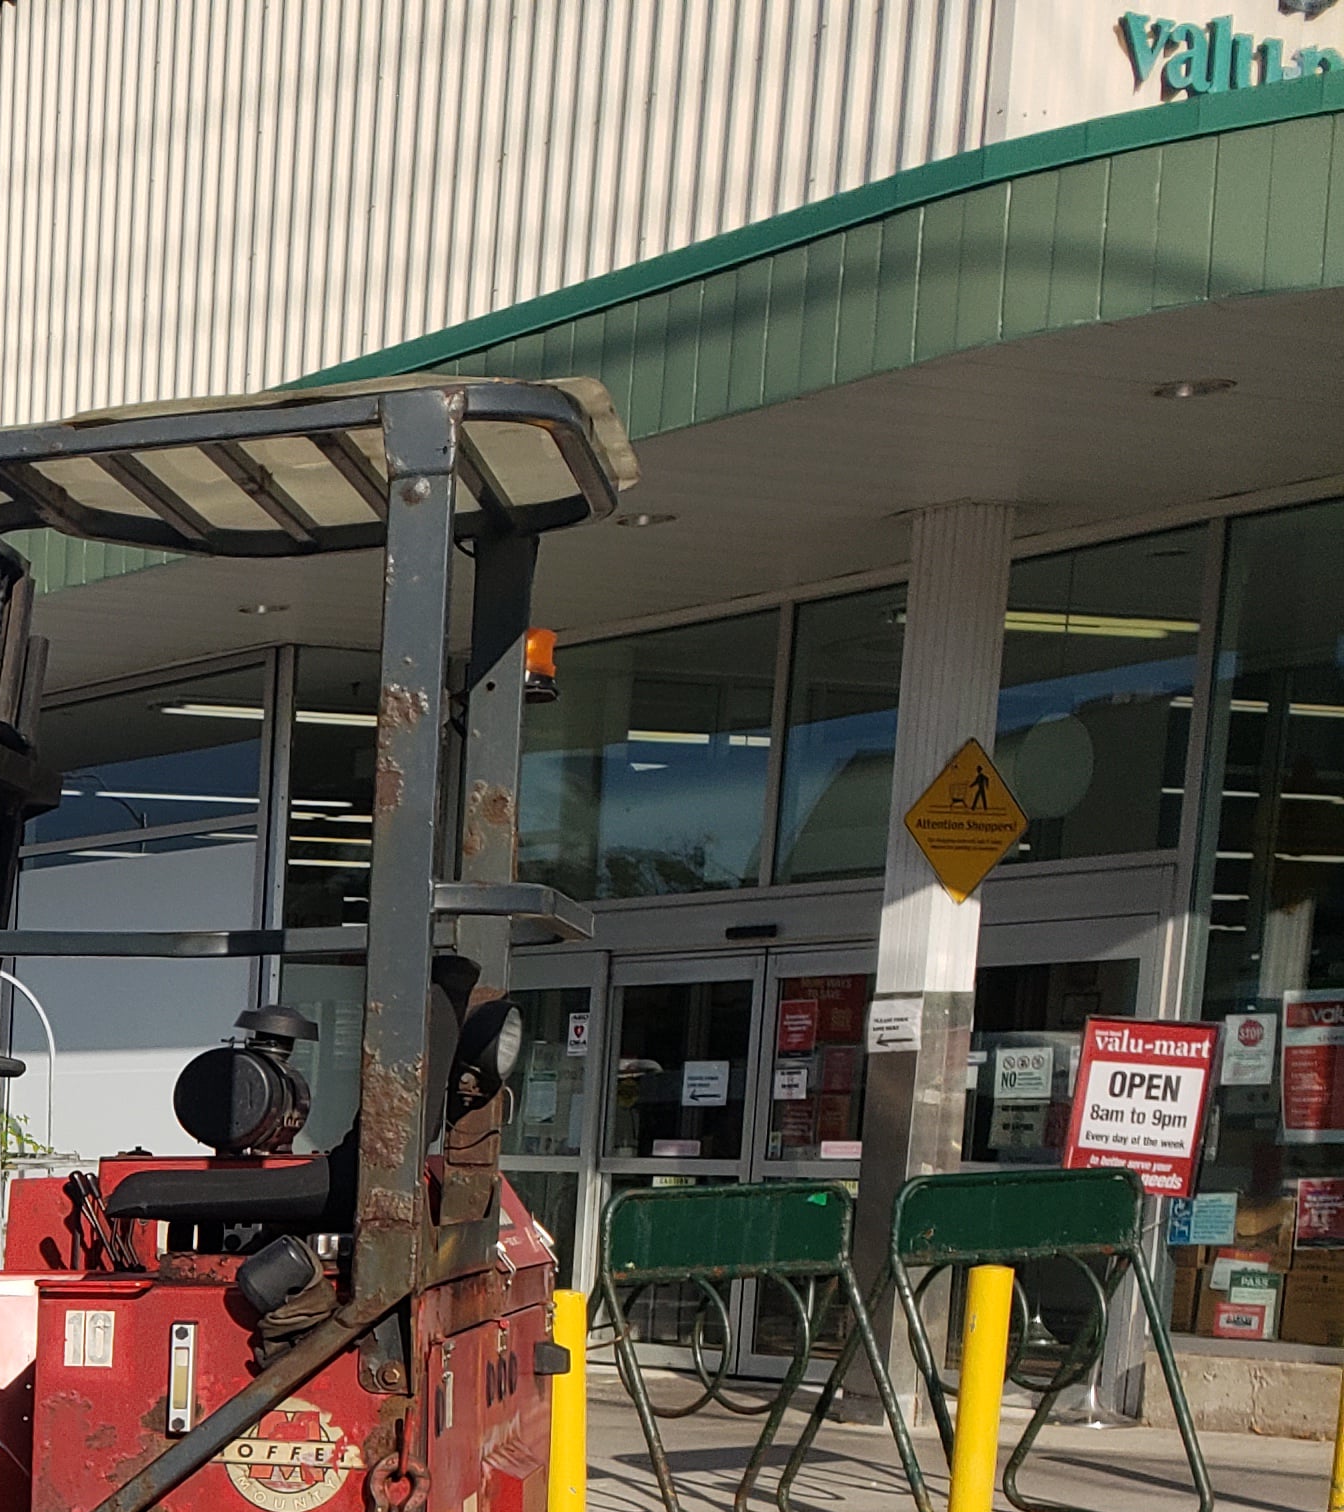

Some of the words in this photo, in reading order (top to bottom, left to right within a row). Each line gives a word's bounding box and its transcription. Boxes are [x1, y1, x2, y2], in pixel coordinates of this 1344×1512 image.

[915, 818, 964, 831] Attention
[965, 820, 1017, 833] Shoppers!
[1095, 1029, 1211, 1059] valu-mart
[1001, 1072, 1017, 1087] NO
[1108, 1071, 1182, 1102] OPEN
[1090, 1104, 1124, 1123] 8am
[1130, 1107, 1146, 1125] to
[1151, 1109, 1188, 1130] 9pm
[1085, 1130, 1111, 1144] Every
[1112, 1132, 1128, 1146] day
[1130, 1136, 1141, 1145] of
[1143, 1136, 1158, 1147] the
[1161, 1139, 1185, 1149] week
[1127, 1161, 1152, 1170] serve
[1152, 1162, 1173, 1173] your
[66, 1311, 113, 1366] 10
[224, 1443, 348, 1463] OFFE
[236, 1476, 337, 1510] MOUNTY
